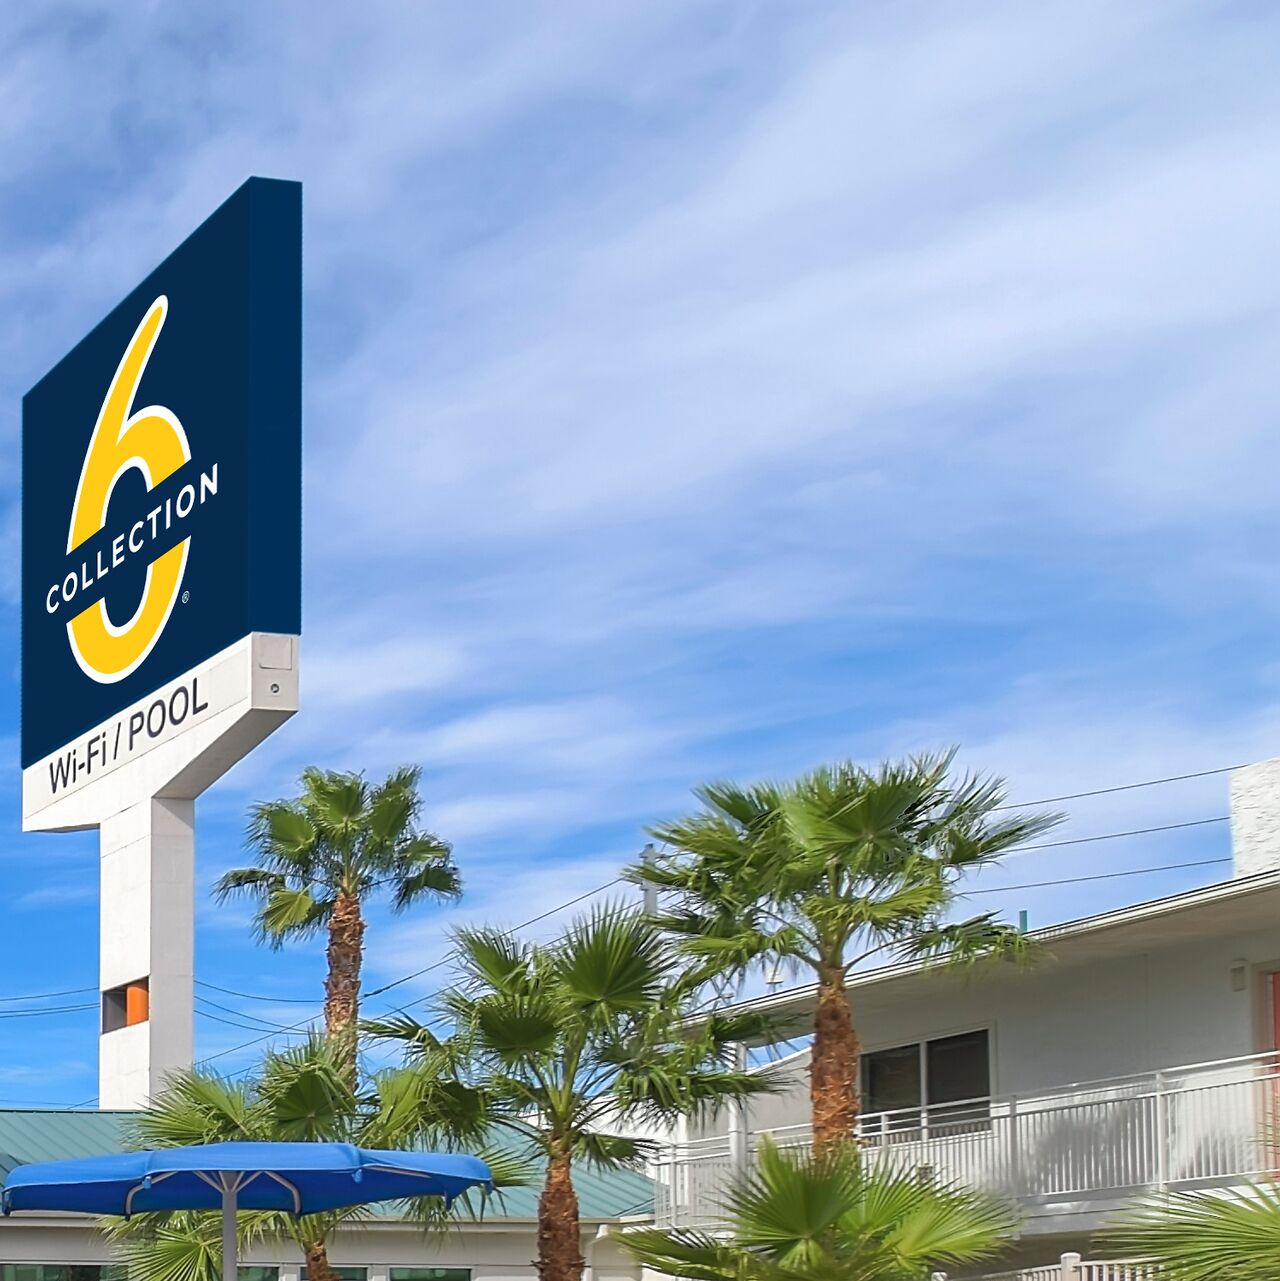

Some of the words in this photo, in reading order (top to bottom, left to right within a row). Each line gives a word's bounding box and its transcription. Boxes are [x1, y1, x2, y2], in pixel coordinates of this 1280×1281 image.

[46, 463, 219, 613] COLLECTION
[66, 294, 192, 684] 6
[49, 731, 106, 794] Wi-Fi
[113, 721, 121, 760] /
[129, 677, 209, 751] POOL
